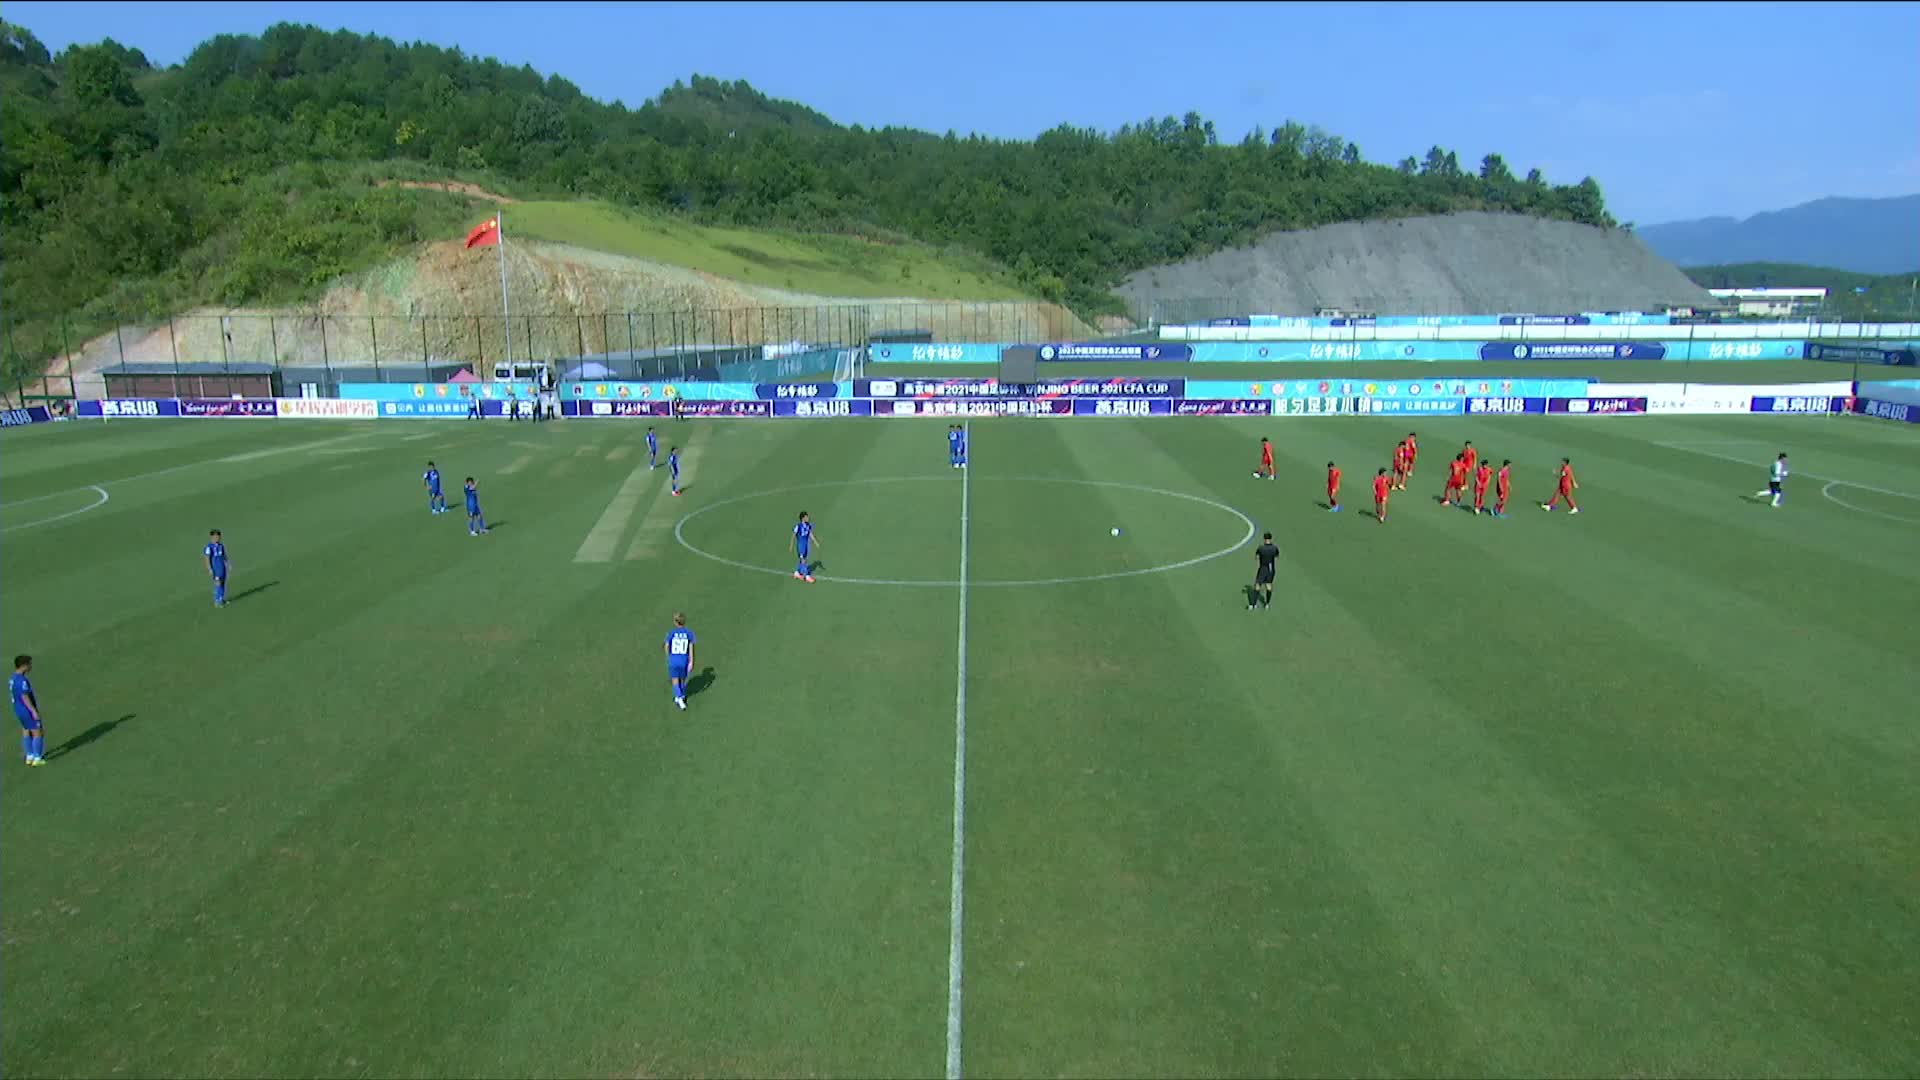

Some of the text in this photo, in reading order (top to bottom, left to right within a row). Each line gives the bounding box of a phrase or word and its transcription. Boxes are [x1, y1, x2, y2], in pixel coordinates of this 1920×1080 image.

[1124, 384, 1144, 394] CFA
[1147, 384, 1168, 394] CUP
[671, 638, 689, 654] 60
